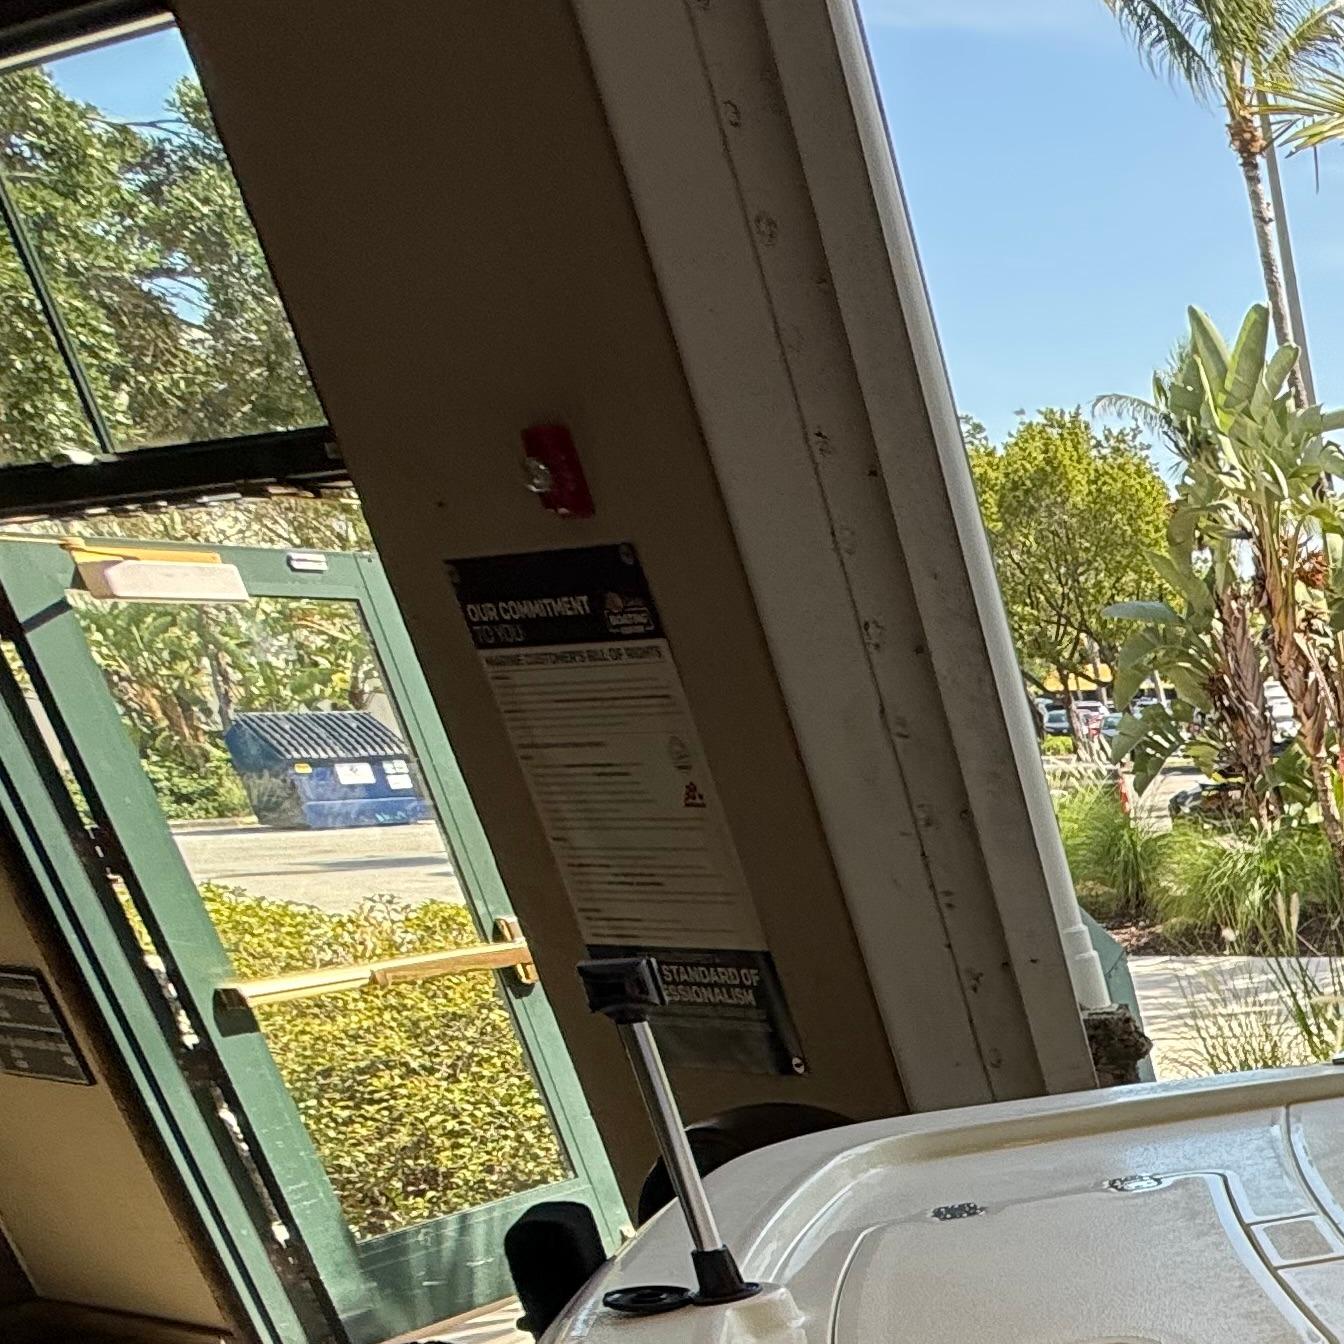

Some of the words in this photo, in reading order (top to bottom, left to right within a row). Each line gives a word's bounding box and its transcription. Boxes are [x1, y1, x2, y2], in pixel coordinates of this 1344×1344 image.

[467, 602, 499, 621] OUR
[500, 595, 591, 619] COMMITMENT
[473, 625, 494, 643] TO
[661, 965, 740, 984] STANDARD
[740, 968, 760, 986] OF
[662, 984, 757, 1006] ESSIONALISM
